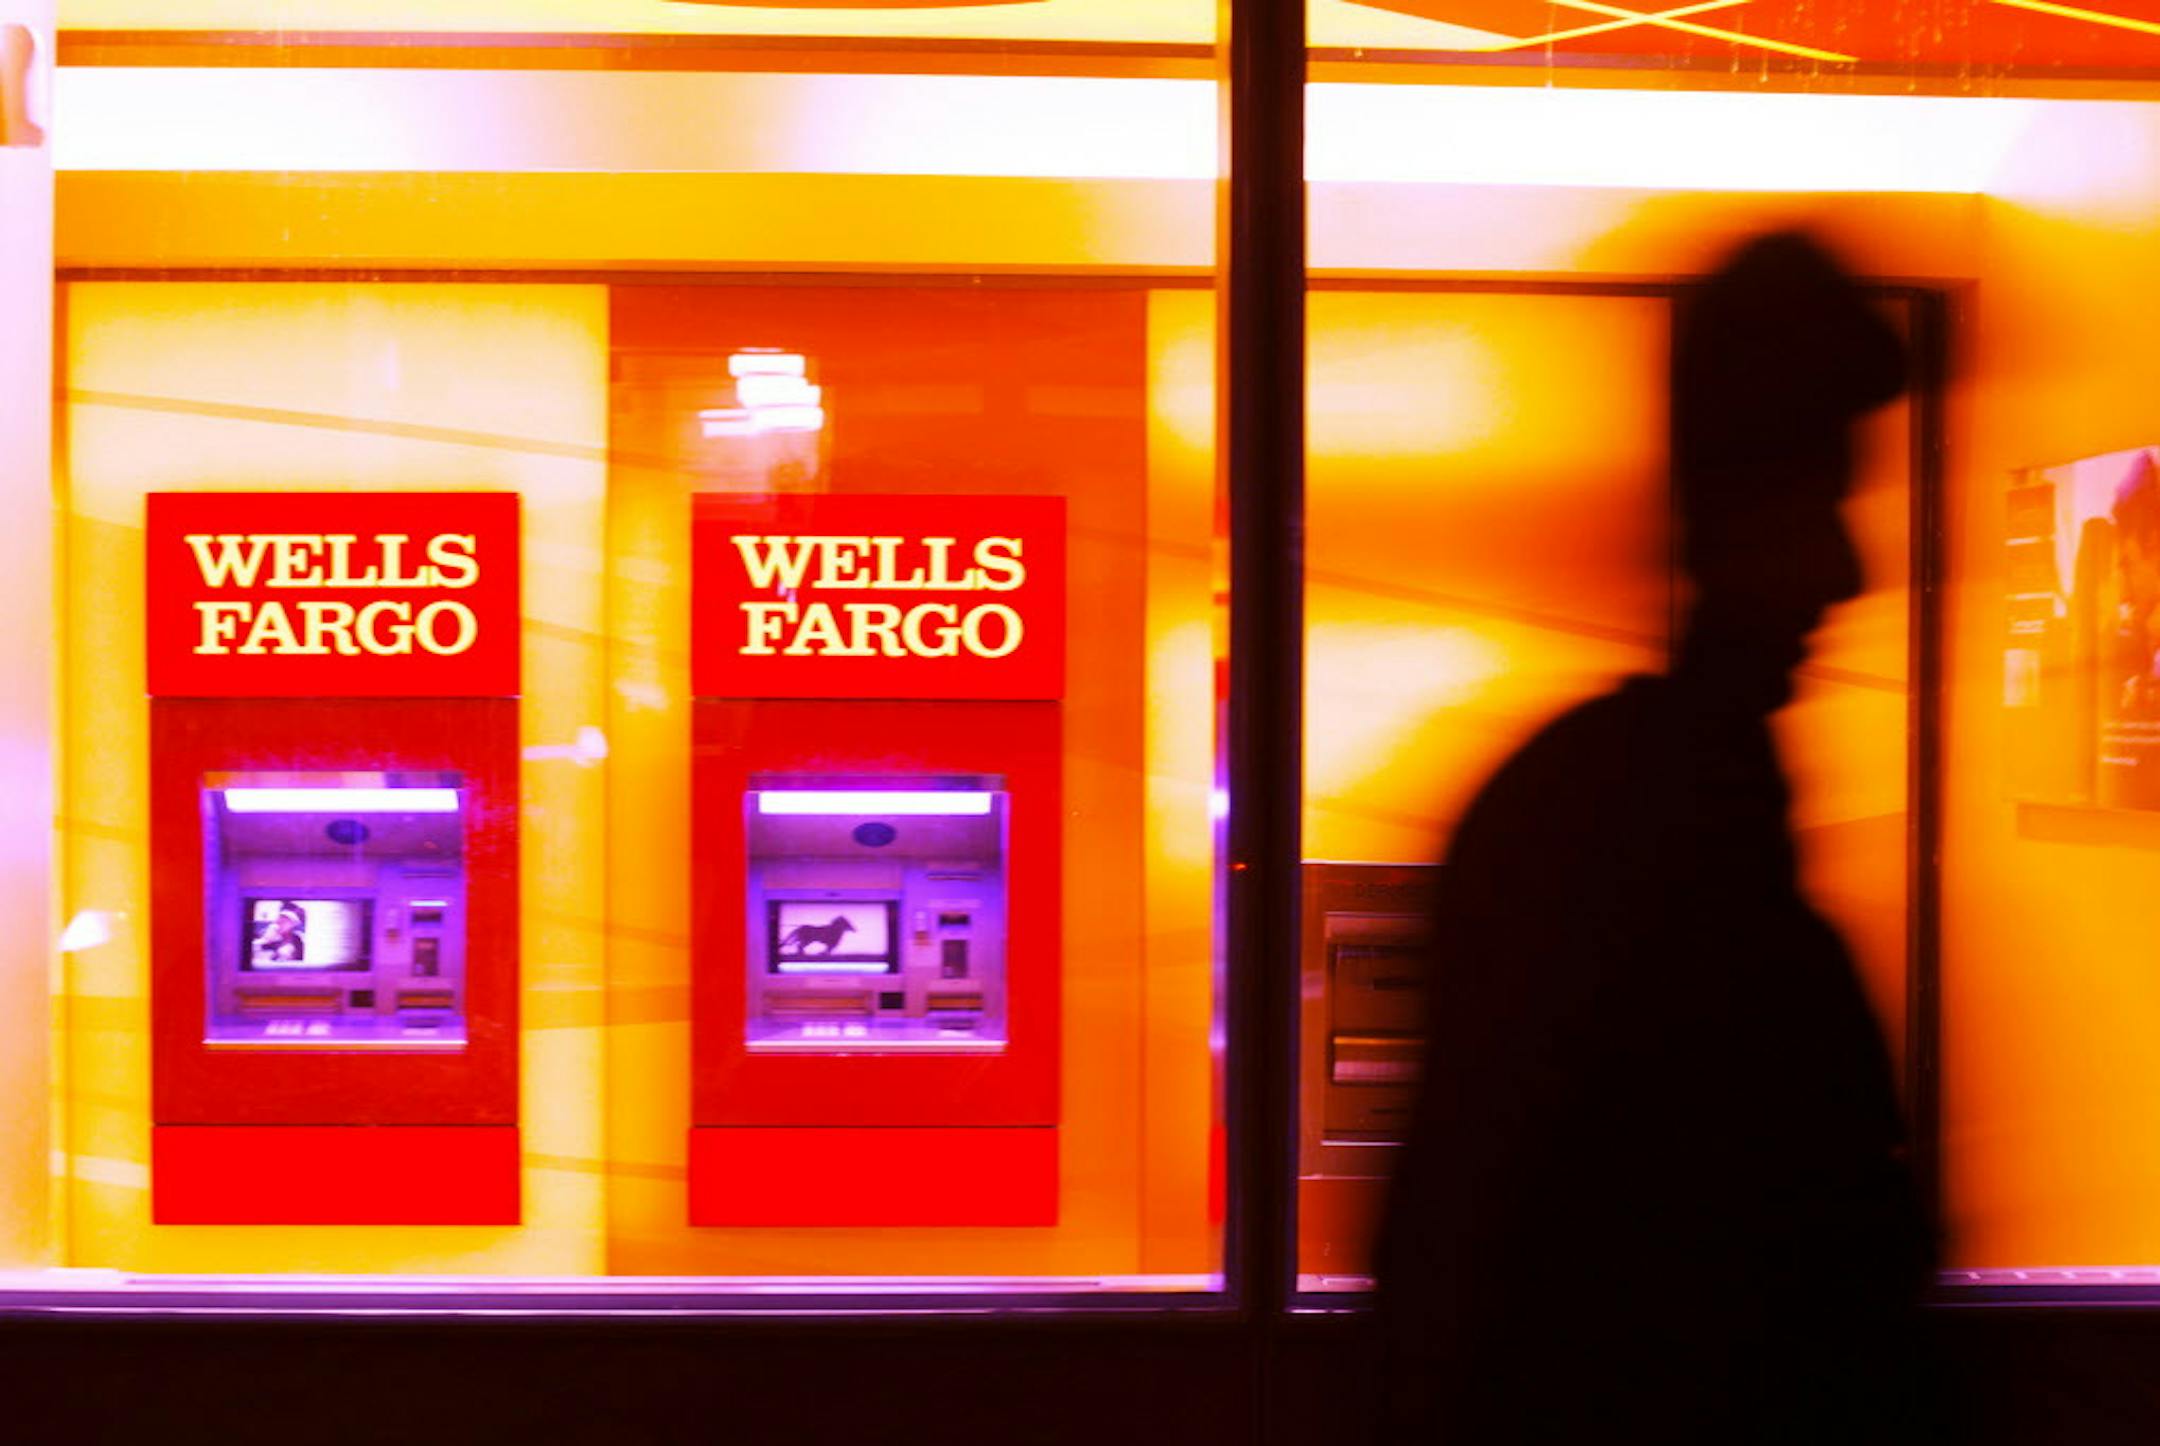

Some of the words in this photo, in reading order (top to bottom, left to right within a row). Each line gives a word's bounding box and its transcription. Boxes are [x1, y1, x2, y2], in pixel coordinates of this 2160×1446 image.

[184, 533, 480, 588] WELLS
[730, 536, 1026, 592] WELLS
[193, 600, 478, 656] FARGO
[739, 602, 1024, 659] FARGO
